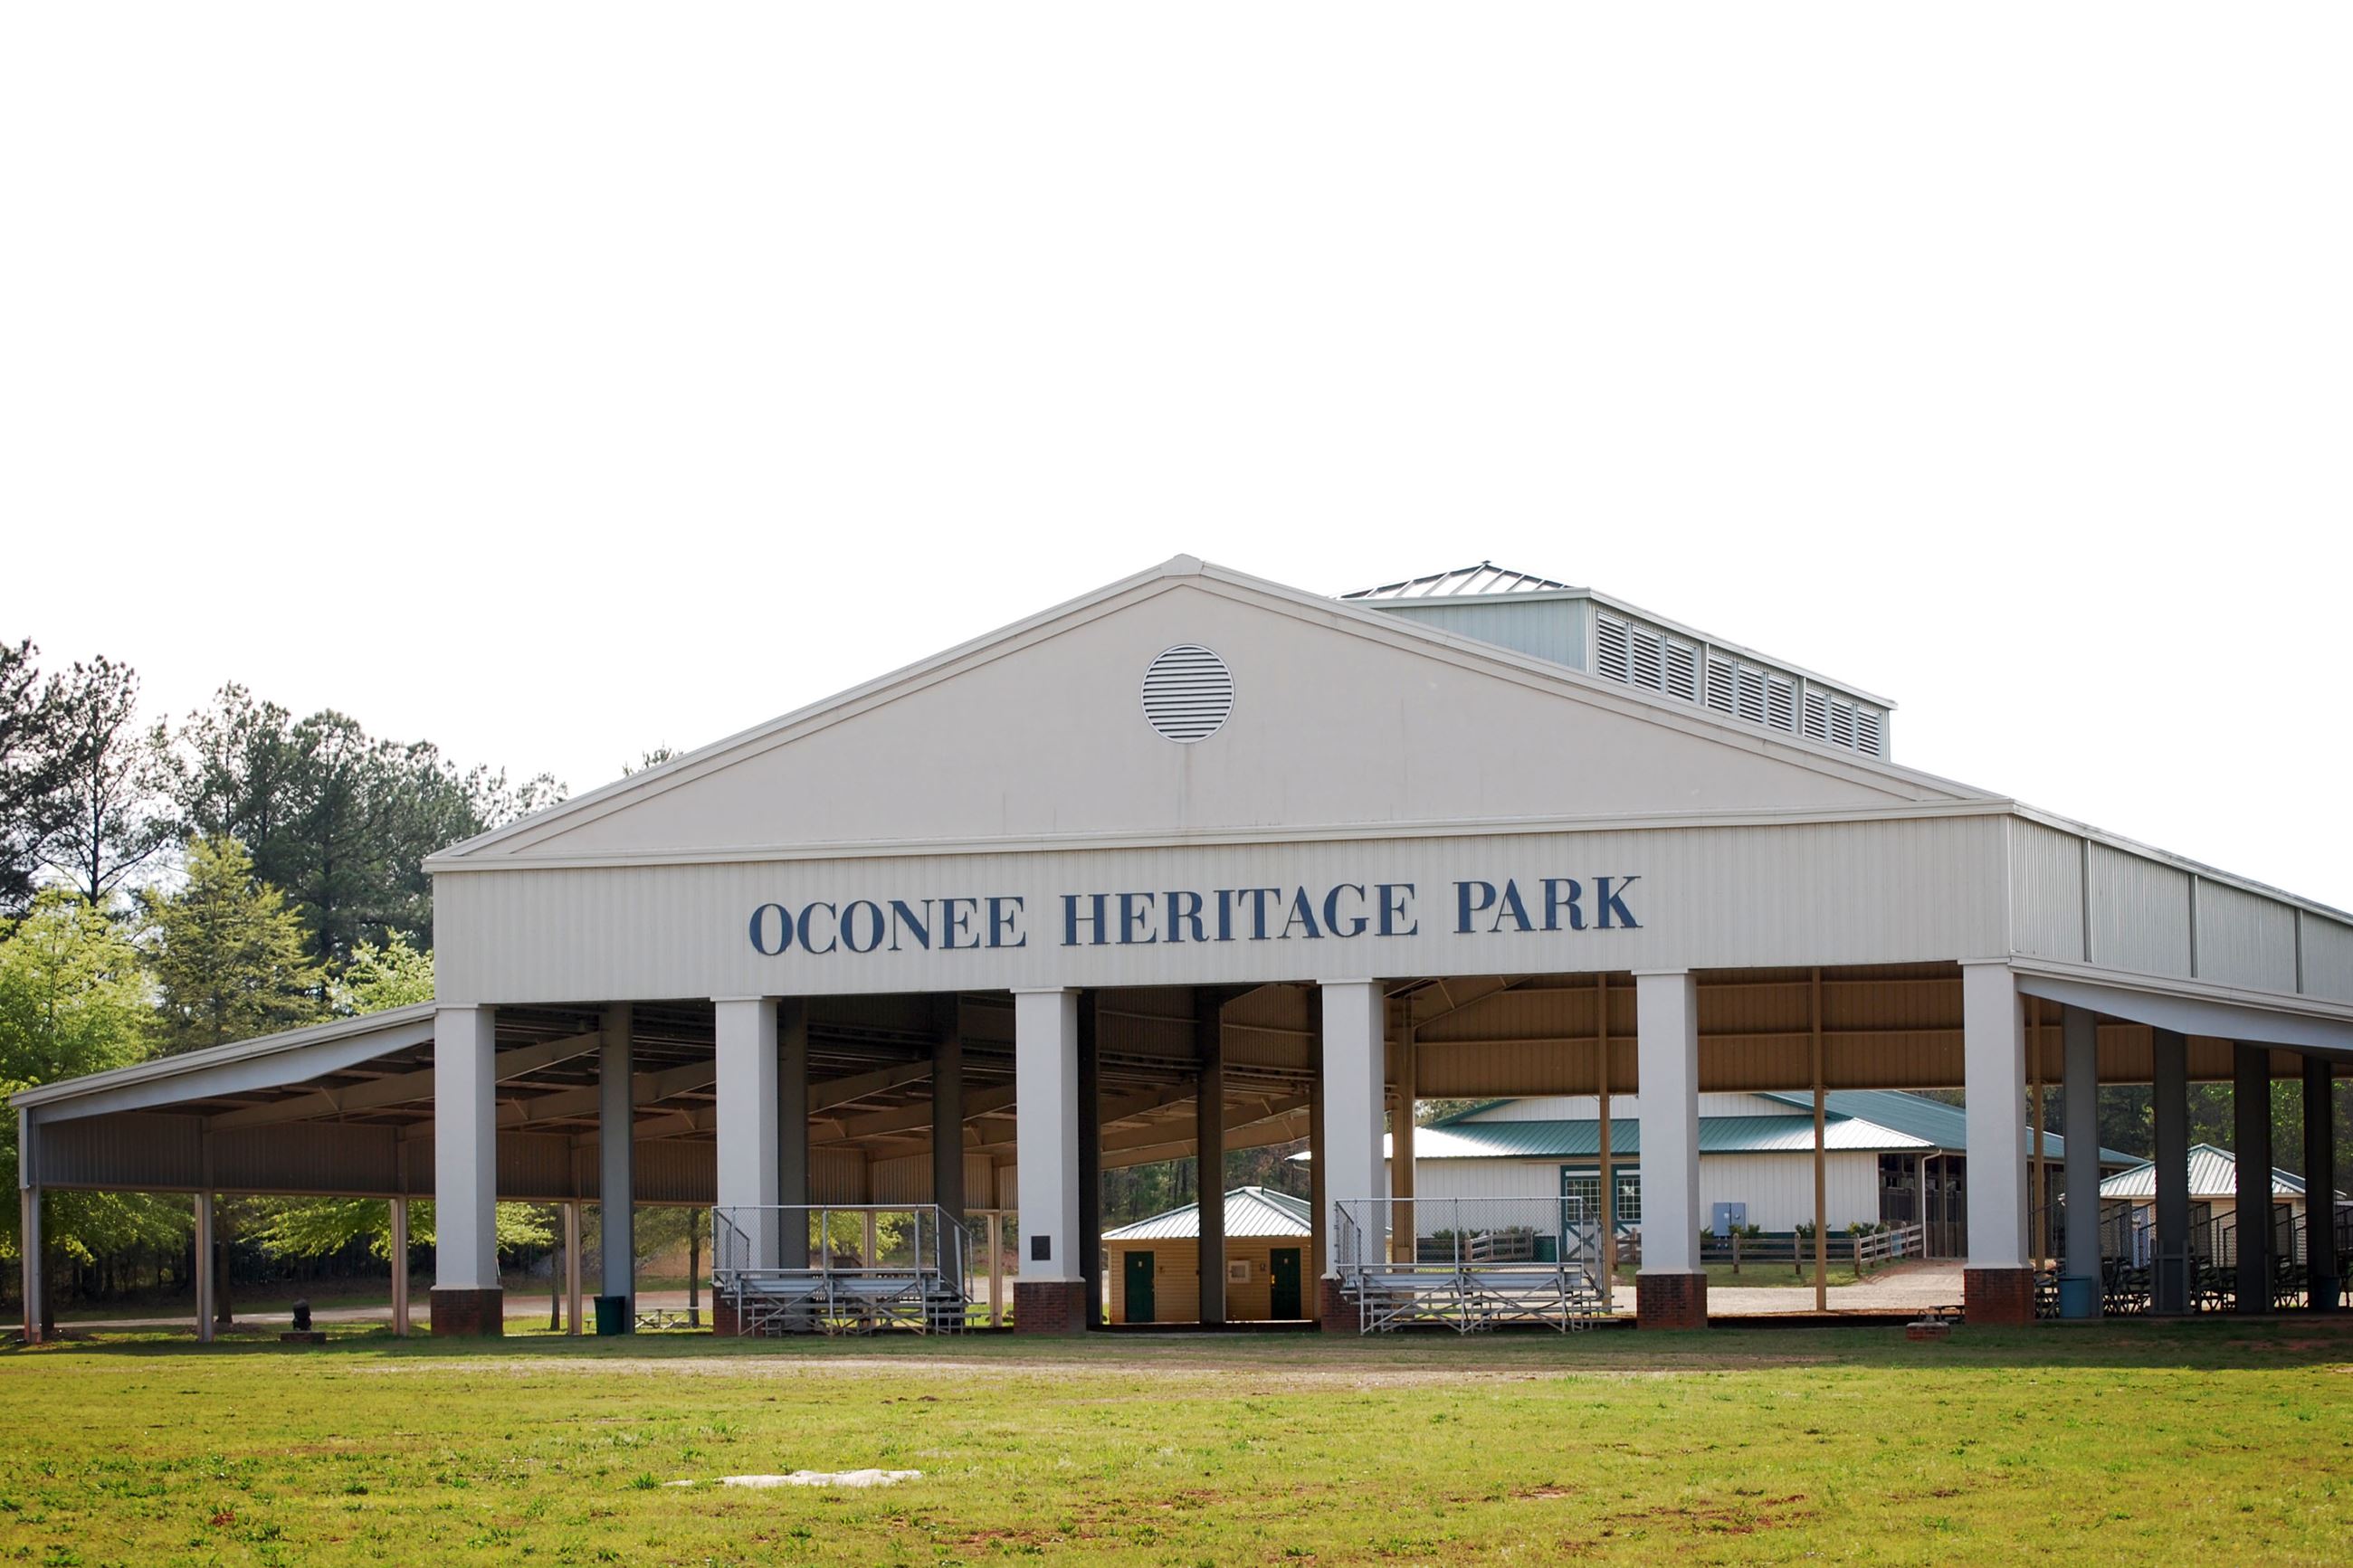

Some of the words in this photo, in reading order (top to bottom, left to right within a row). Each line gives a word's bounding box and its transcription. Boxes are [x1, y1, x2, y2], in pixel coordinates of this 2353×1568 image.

[749, 896, 1027, 956] OCONEE
[1060, 883, 1418, 947] HERITAGE
[1453, 875, 1644, 933] PARK
